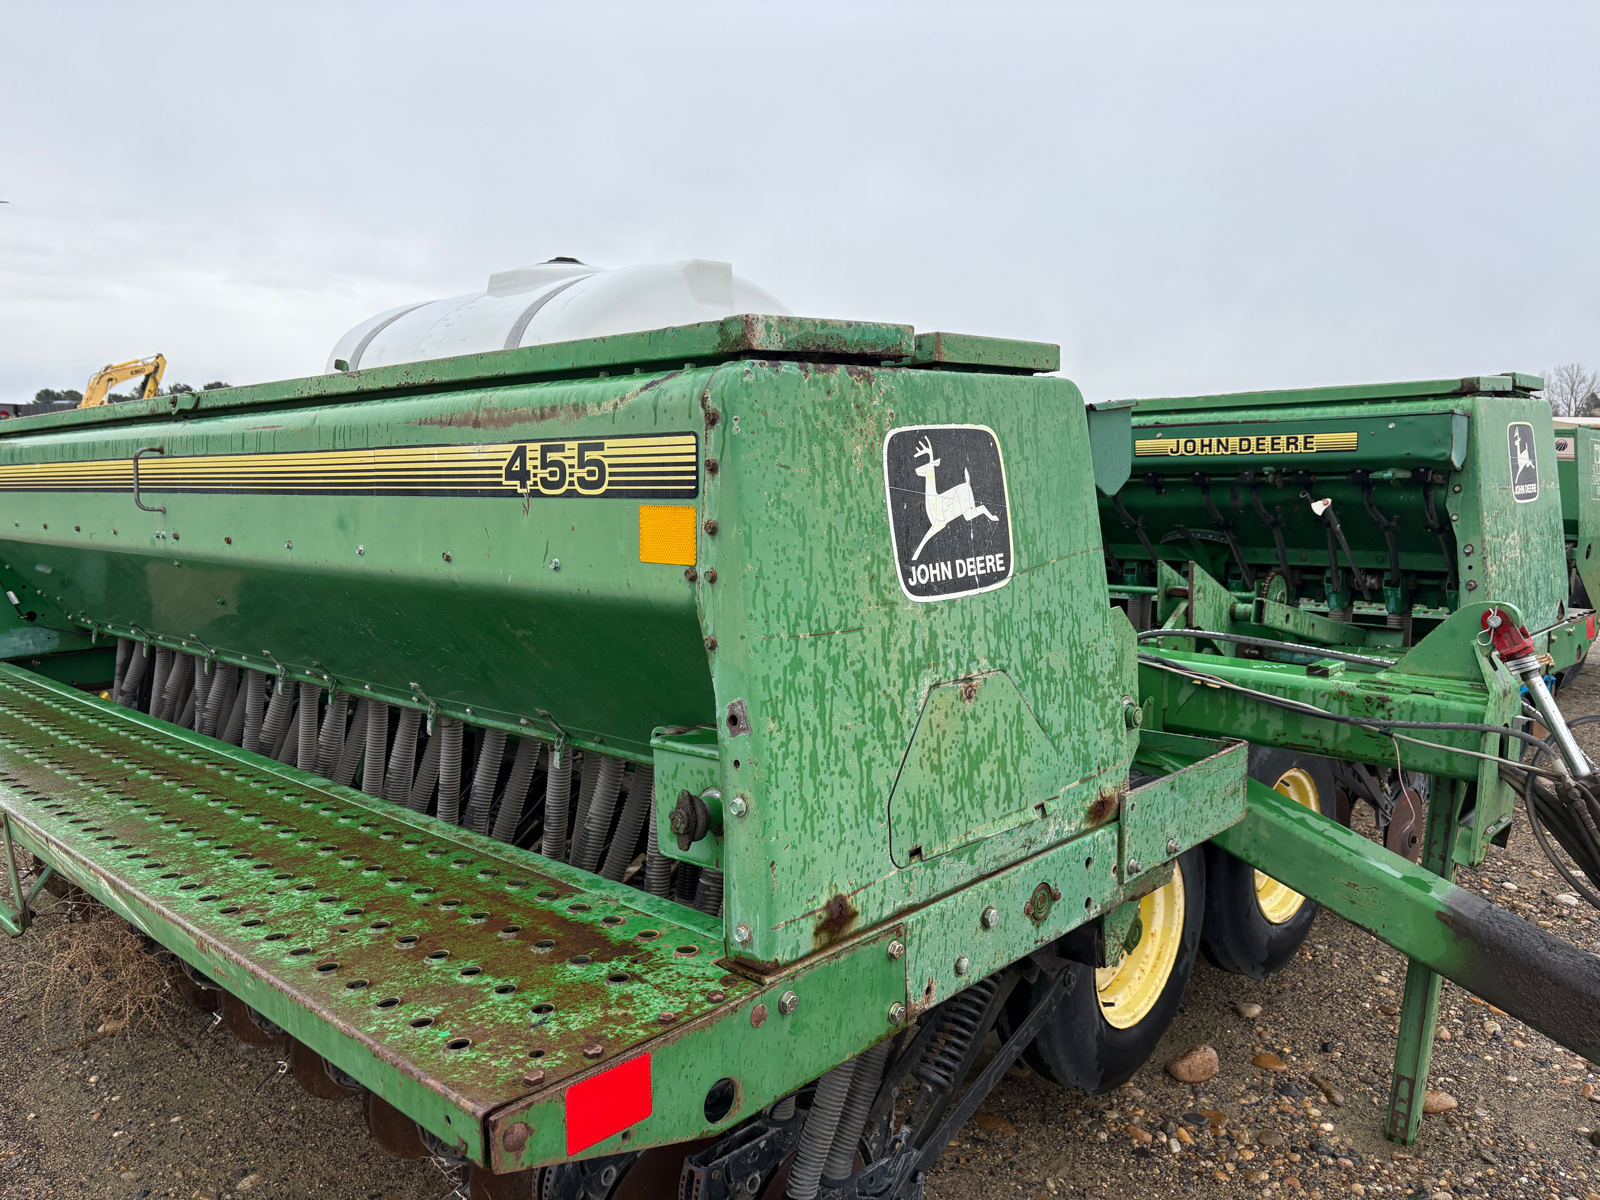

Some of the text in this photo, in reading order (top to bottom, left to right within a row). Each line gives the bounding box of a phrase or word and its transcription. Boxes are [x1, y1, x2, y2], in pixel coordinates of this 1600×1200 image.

[1169, 435, 1316, 456] JOHN DEERE
[504, 441, 607, 492] 455
[908, 553, 1006, 586] JOHN DEERE
